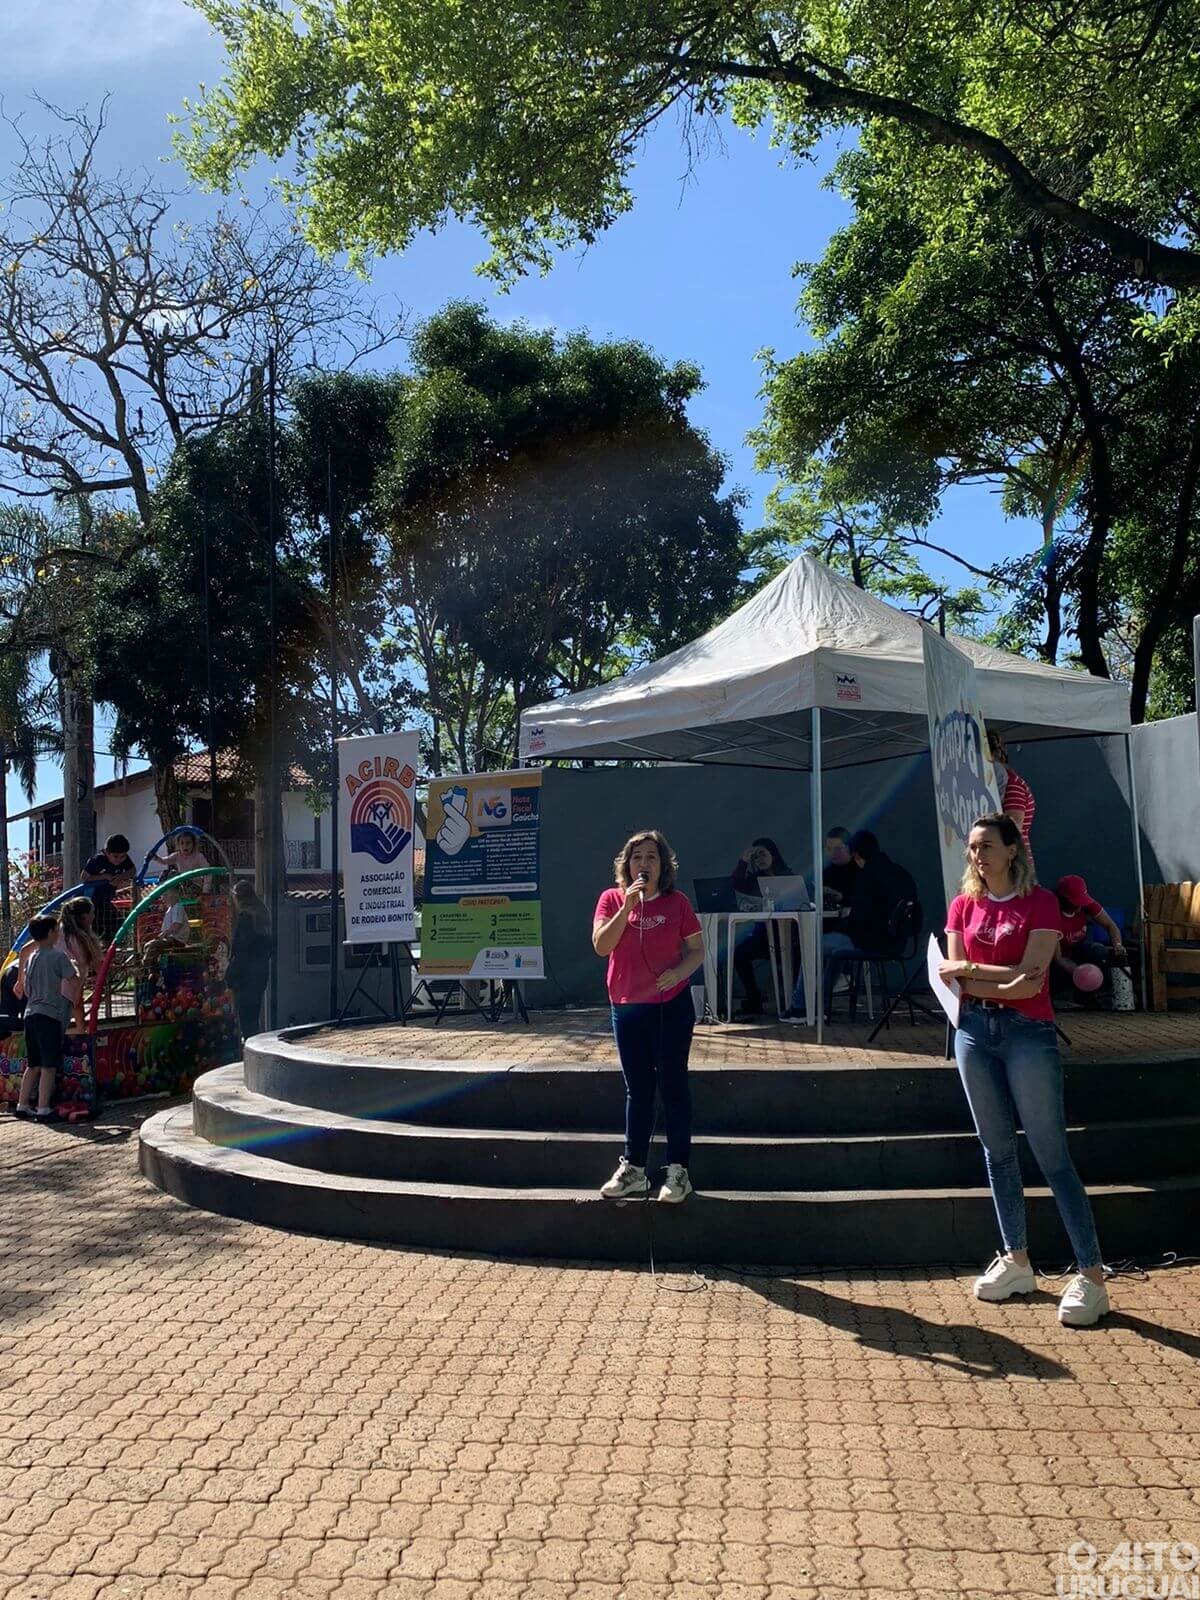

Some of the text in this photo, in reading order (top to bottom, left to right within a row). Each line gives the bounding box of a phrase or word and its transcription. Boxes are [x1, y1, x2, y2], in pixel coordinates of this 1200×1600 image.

[934, 718, 979, 786] Compra
[345, 756, 416, 796] ACIRB
[360, 871, 405, 883] ASSOCIAÇÃO
[363, 886, 402, 896] COMERCIAL
[360, 900, 405, 910] E INDUSTRIAL
[352, 912, 414, 924] DE RODEIO BONITO
[432, 914, 437, 926] 1
[491, 914, 498, 926] 3
[430, 929, 437, 940] 2
[489, 930, 496, 942] 4
